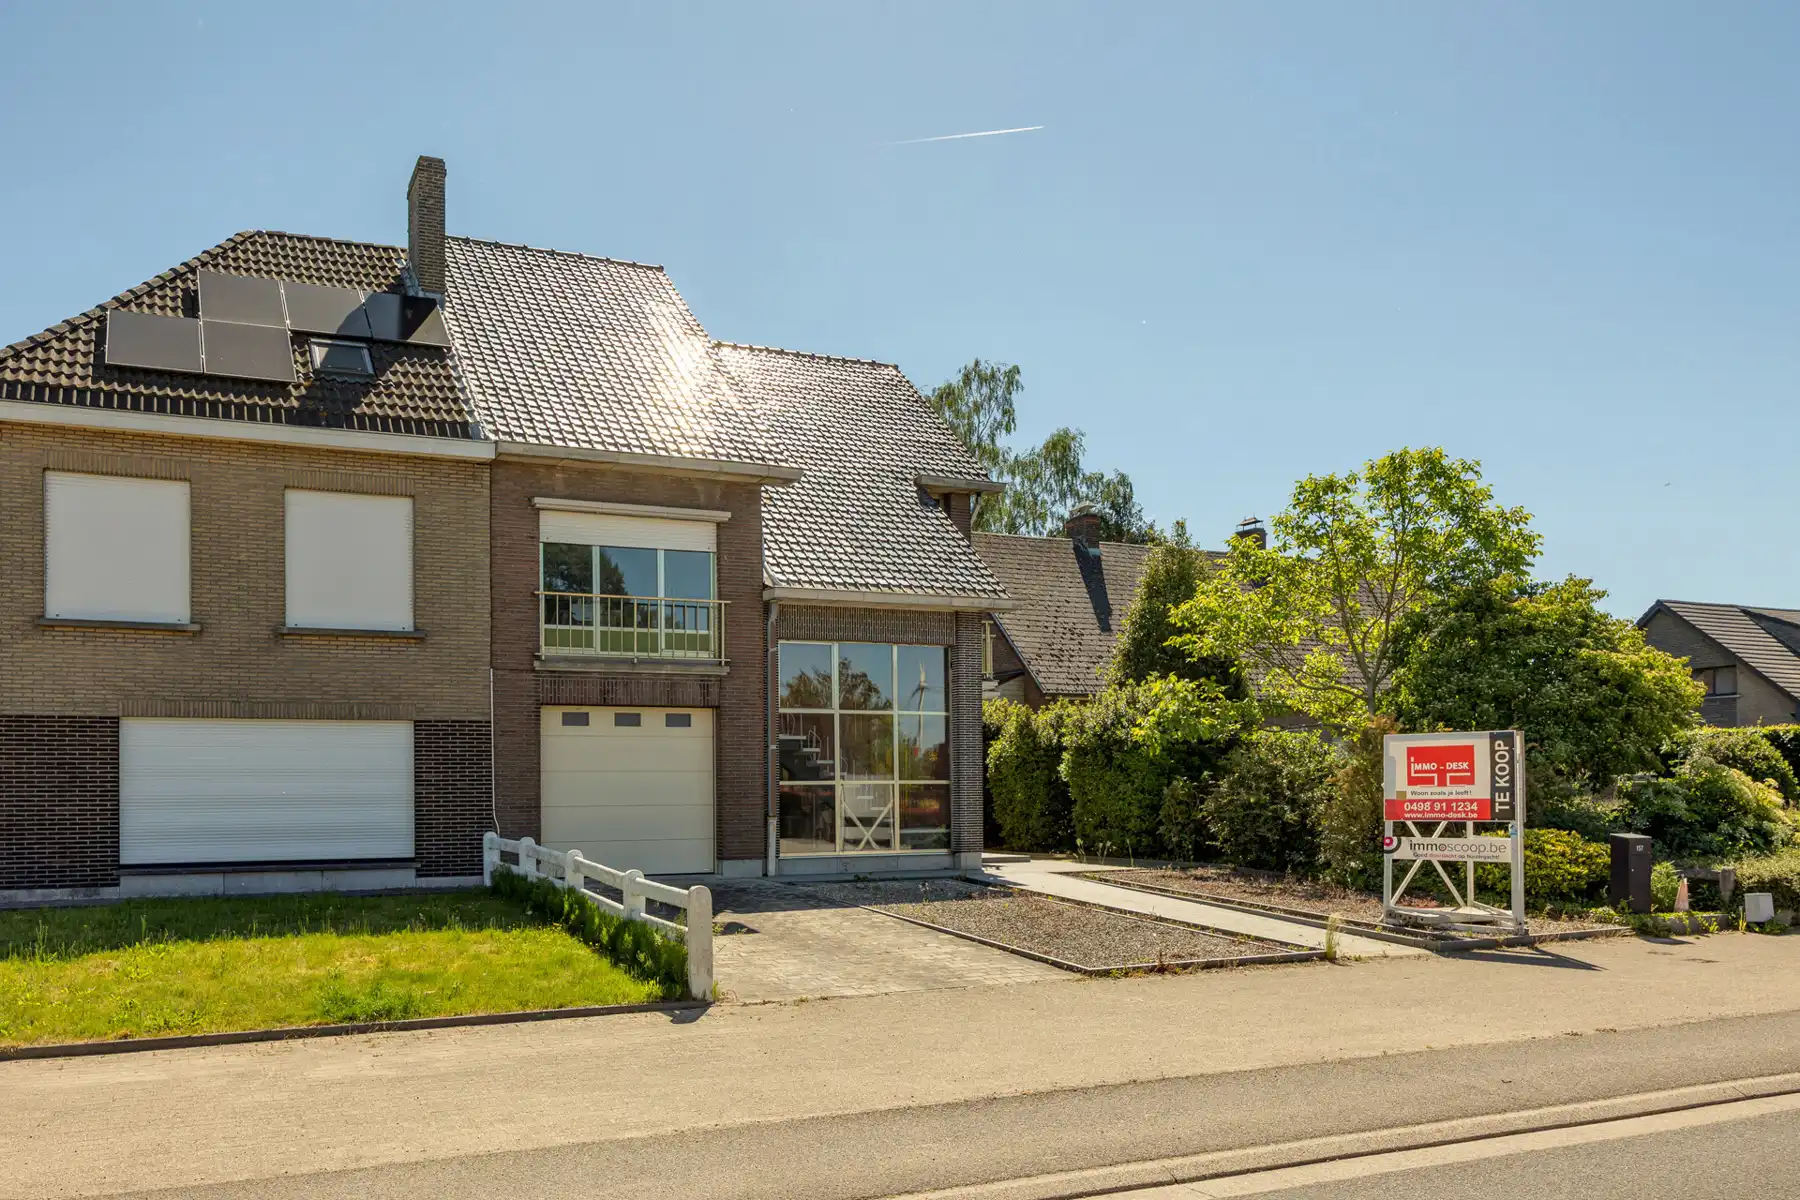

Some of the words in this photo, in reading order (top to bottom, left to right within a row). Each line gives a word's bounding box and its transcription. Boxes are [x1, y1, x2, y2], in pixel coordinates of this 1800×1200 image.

[1446, 762, 1470, 770] DESK
[1494, 740, 1510, 787] KOOP
[1404, 802, 1431, 811] 0498
[1433, 802, 1447, 811] 91
[1450, 801, 1478, 811] 1234
[1495, 791, 1510, 813] TE
[1409, 839, 1507, 854] immoscoop.be
